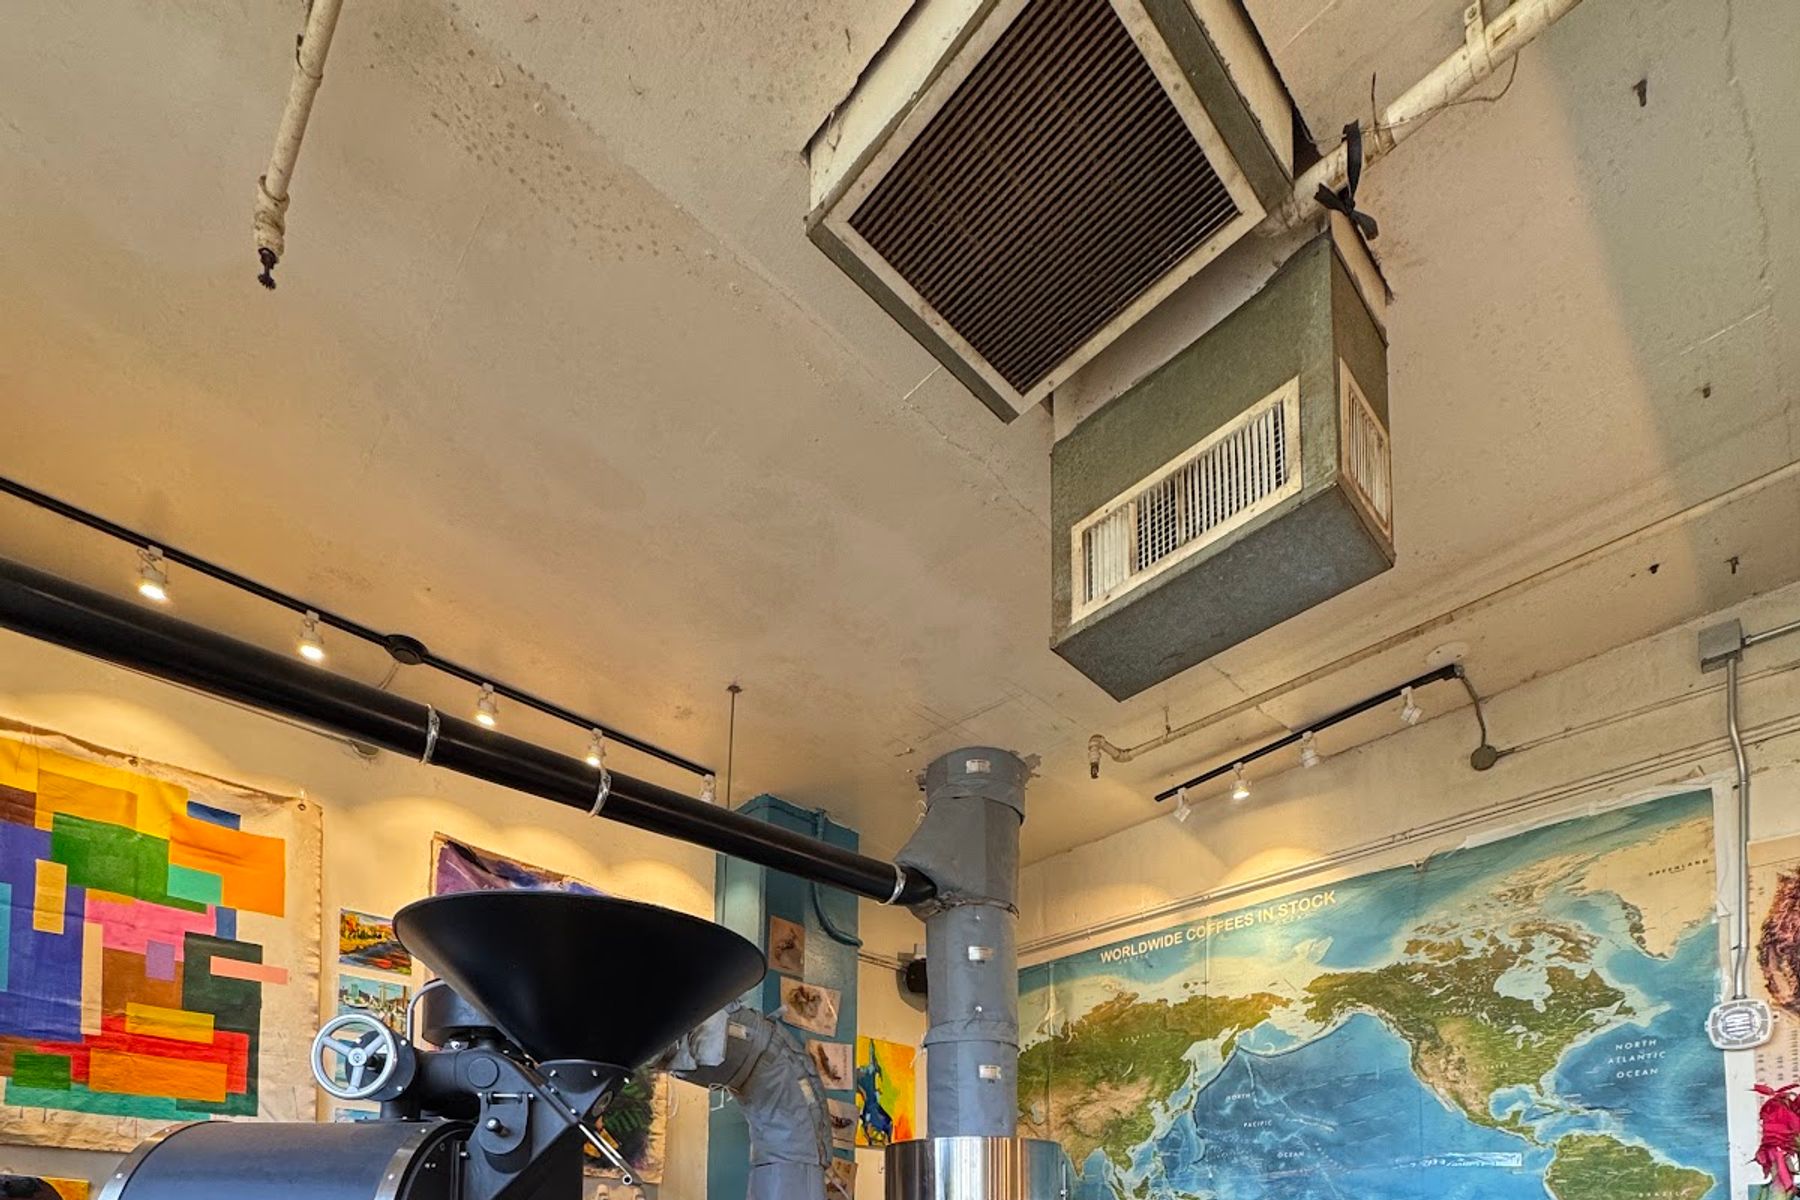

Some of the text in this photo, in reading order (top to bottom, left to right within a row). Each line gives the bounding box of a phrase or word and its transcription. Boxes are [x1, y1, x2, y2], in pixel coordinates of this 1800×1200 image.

[1100, 931, 1183, 963] WORLDWIDE
[1186, 911, 1255, 942] COFFEES
[1258, 906, 1276, 924] IN
[1278, 890, 1337, 918] STOCK
[1616, 1039, 1657, 1051] NORTH
[1607, 1050, 1667, 1064] ATLANTIC
[1615, 1068, 1659, 1079] OCEAN
[1243, 1119, 1273, 1128] PACIFIC
[1276, 1151, 1305, 1159] OCEAN
